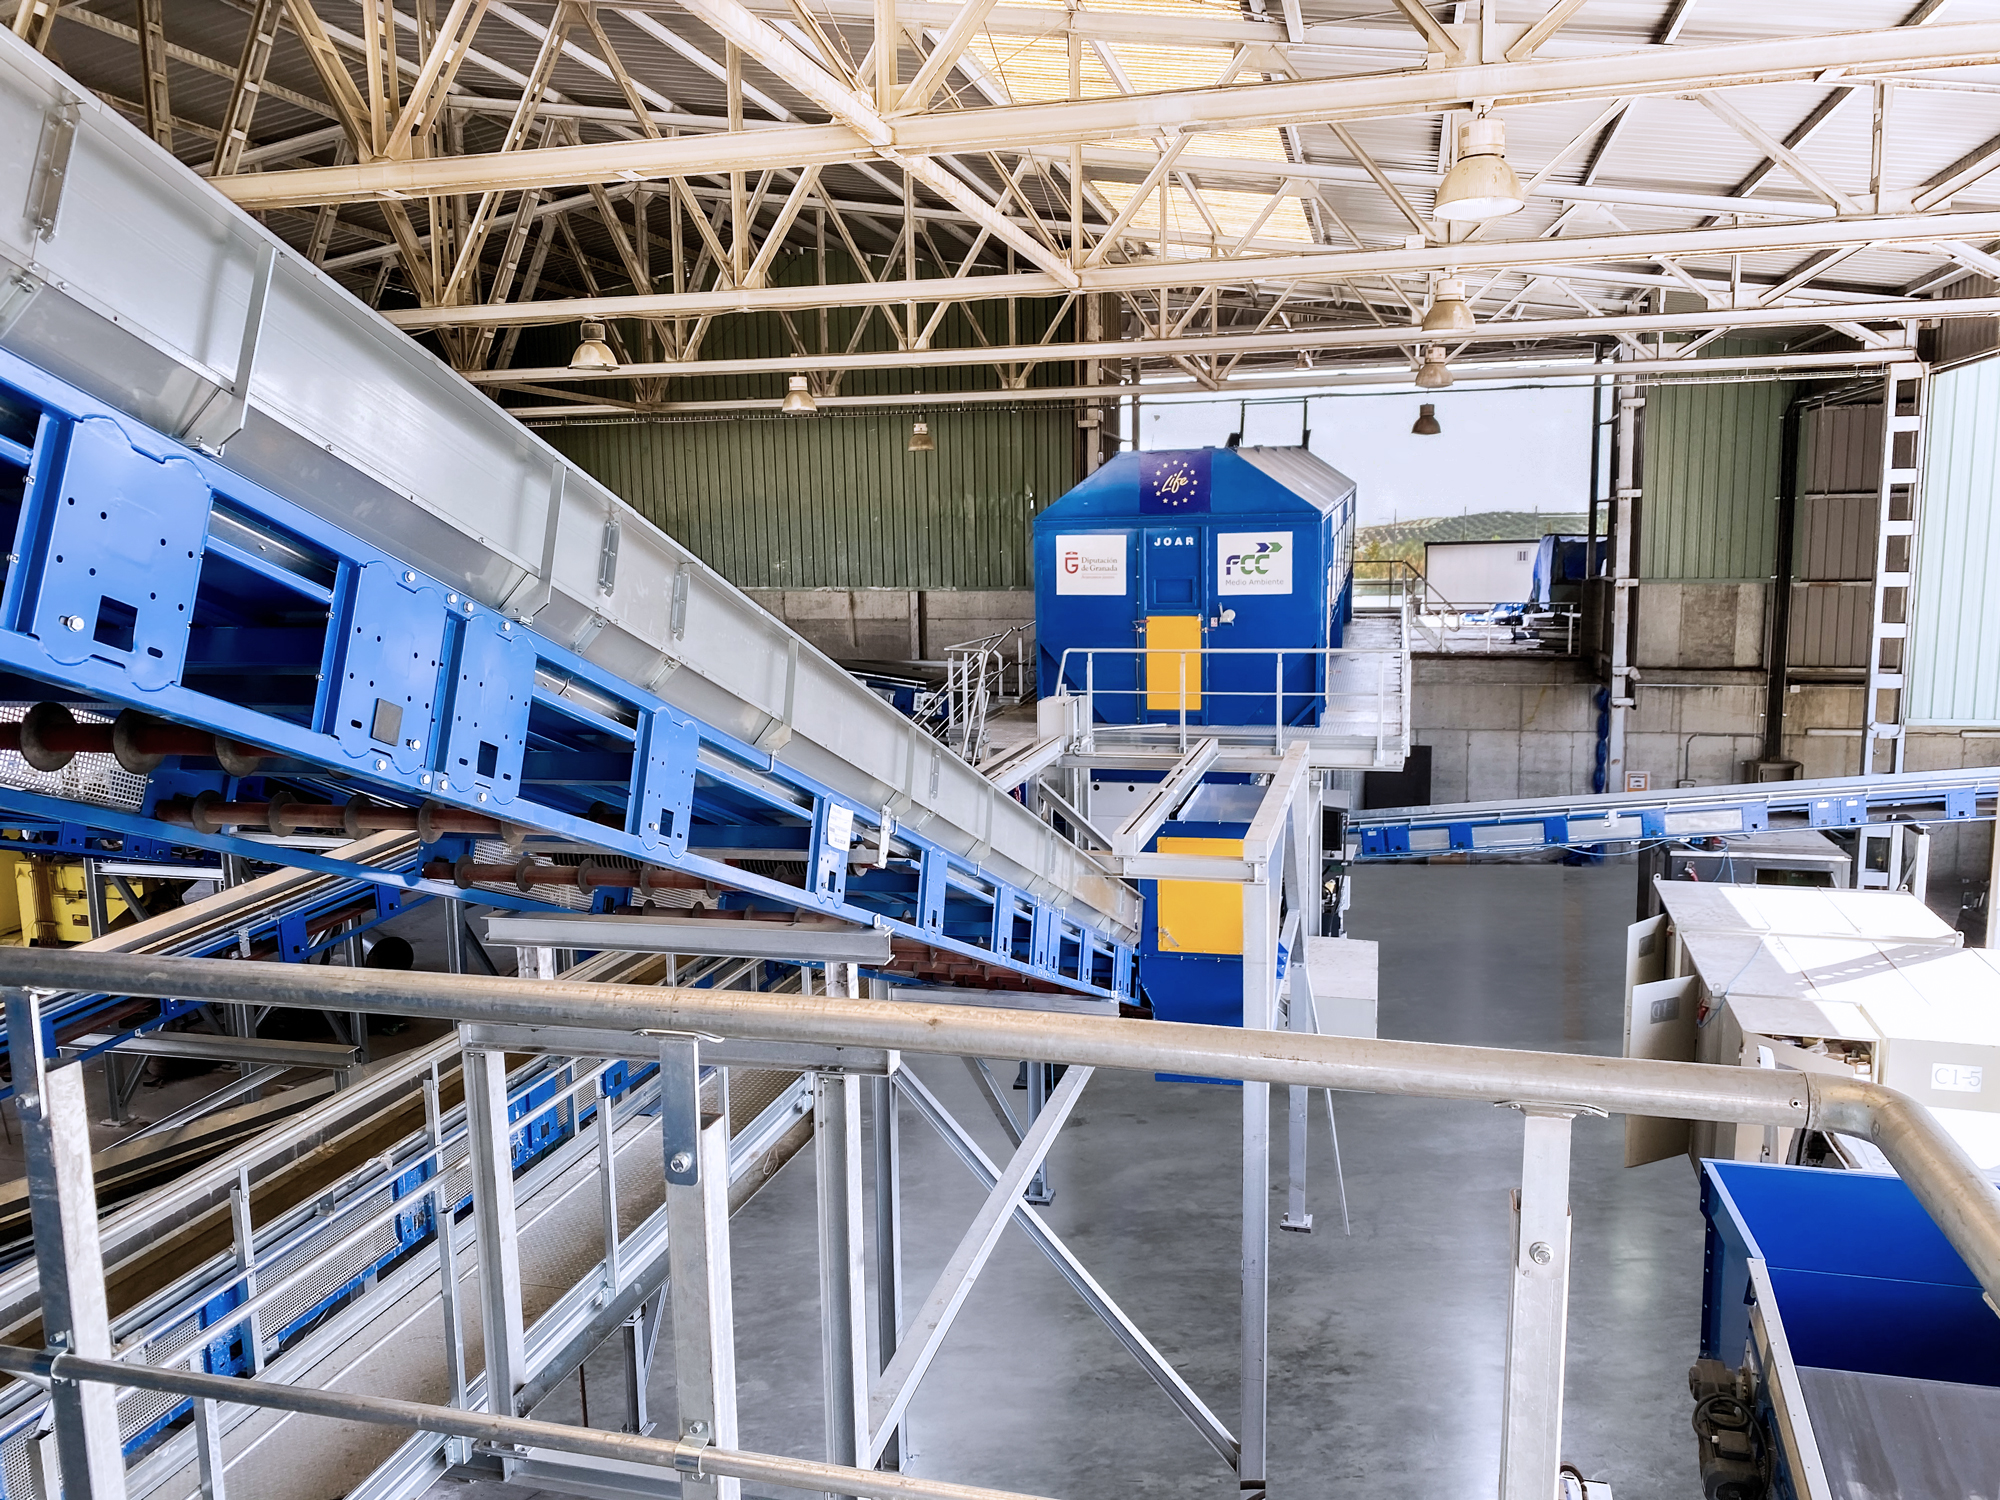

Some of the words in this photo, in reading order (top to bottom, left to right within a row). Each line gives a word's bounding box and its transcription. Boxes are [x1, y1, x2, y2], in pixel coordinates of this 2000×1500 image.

[1161, 470, 1188, 493] Life
[1154, 537, 1194, 546] JOAR
[1226, 554, 1270, 575] FCC
